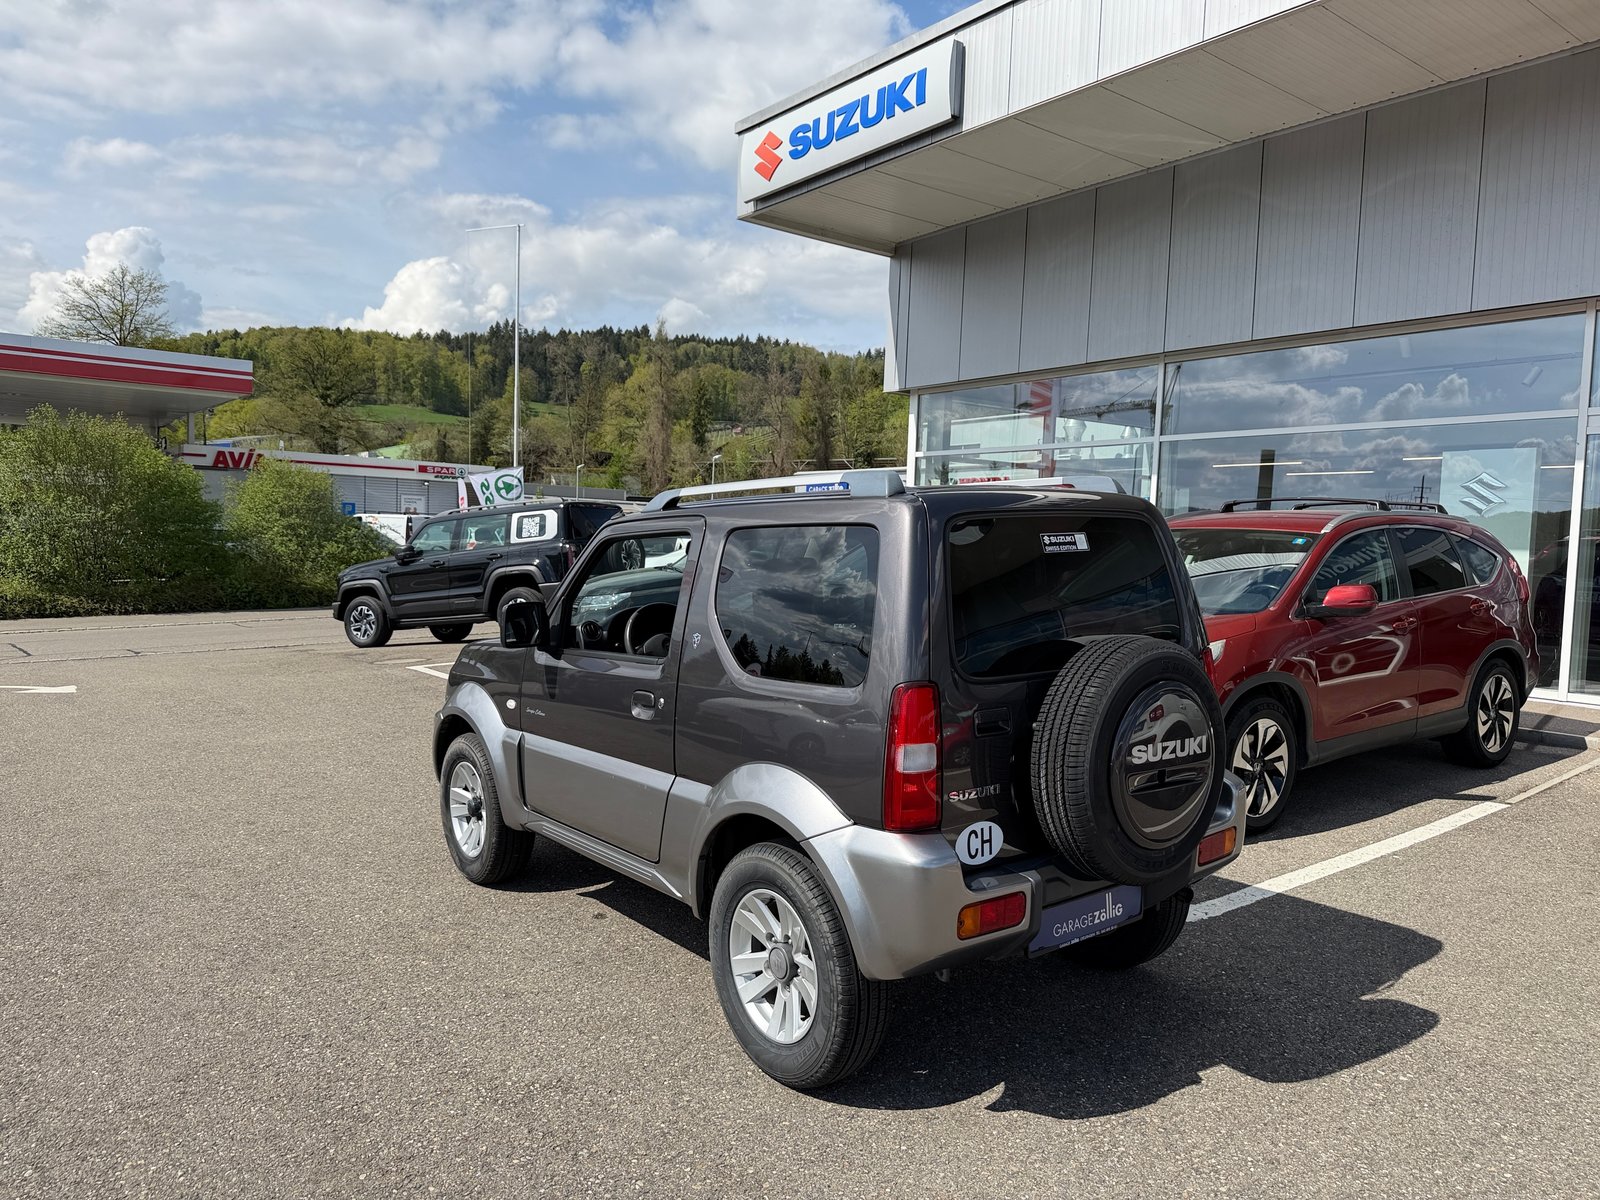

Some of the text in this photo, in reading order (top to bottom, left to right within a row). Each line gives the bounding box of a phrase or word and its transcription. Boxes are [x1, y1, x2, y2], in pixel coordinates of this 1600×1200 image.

[788, 67, 928, 160] SUZUKI
[426, 466, 457, 475] SPAR
[1049, 535, 1075, 543] SUZUKI
[1131, 735, 1207, 765] SUZUKI
[949, 784, 1000, 802] SUZUKI
[967, 826, 992, 859] CH
